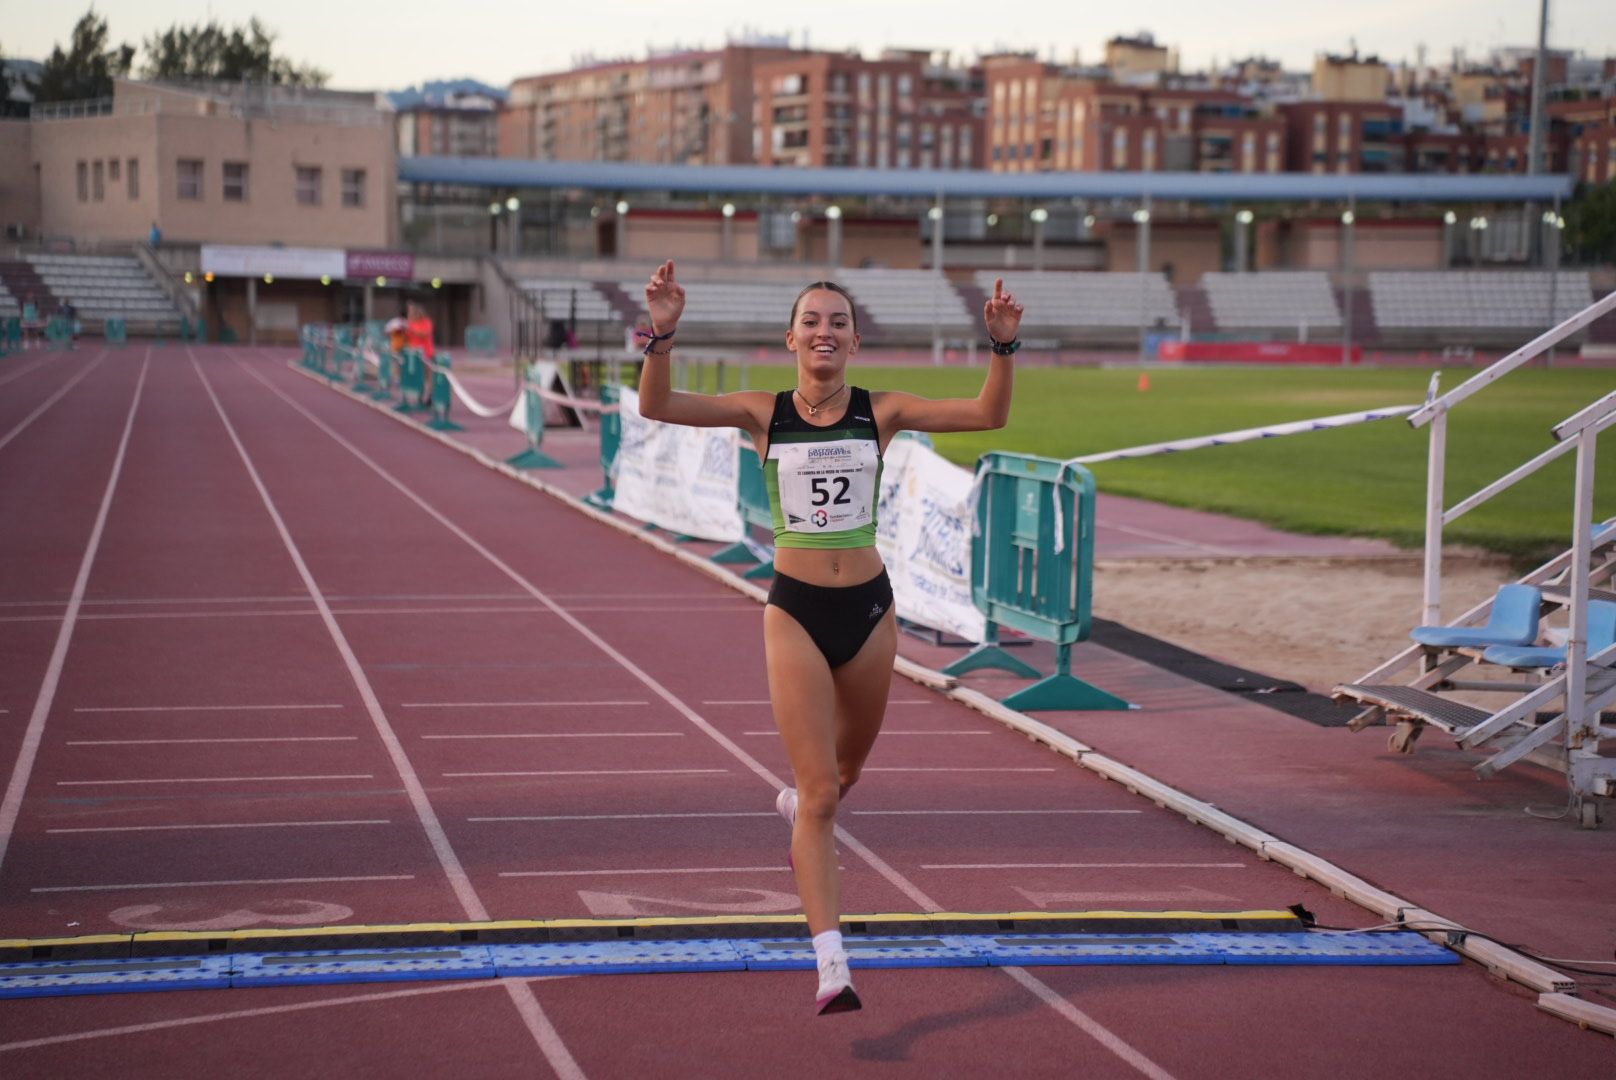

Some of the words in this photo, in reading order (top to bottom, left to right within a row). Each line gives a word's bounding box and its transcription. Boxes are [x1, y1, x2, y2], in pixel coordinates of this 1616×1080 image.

[811, 476, 851, 506] 52
[108, 899, 354, 931] 3
[576, 887, 803, 917] 2
